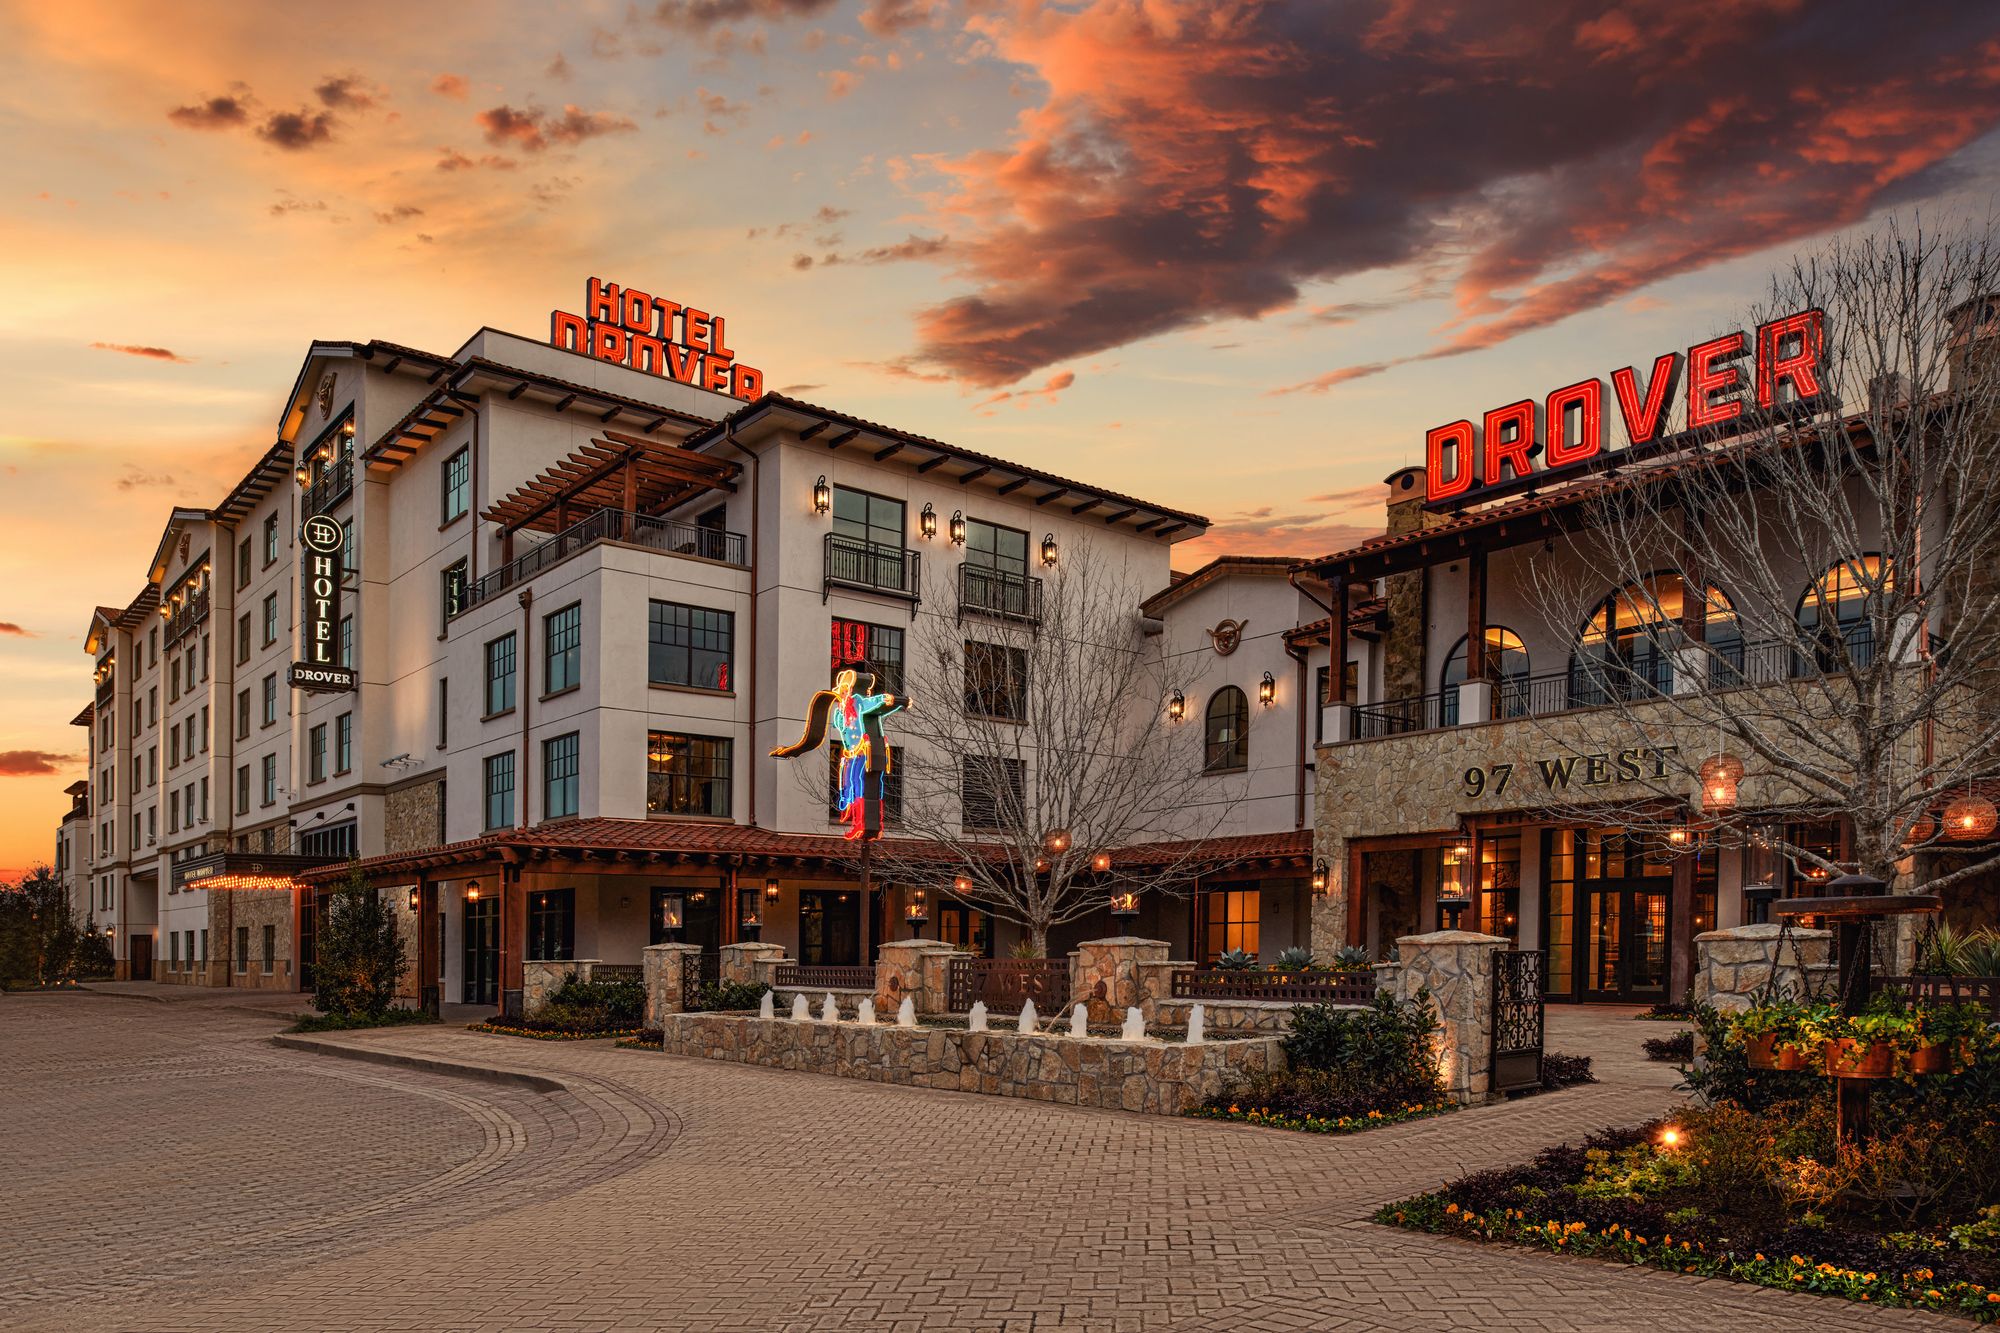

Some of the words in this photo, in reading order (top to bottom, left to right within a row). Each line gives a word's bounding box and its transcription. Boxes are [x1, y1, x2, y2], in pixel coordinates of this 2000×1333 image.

[551, 310, 763, 401] DROVER
[587, 277, 734, 360] HOTEL
[1426, 308, 1830, 502] DROVER
[313, 556, 332, 663] HOTEL
[294, 668, 351, 685] DROVER
[1464, 763, 1514, 798] 97
[1535, 745, 1678, 789] WEST
